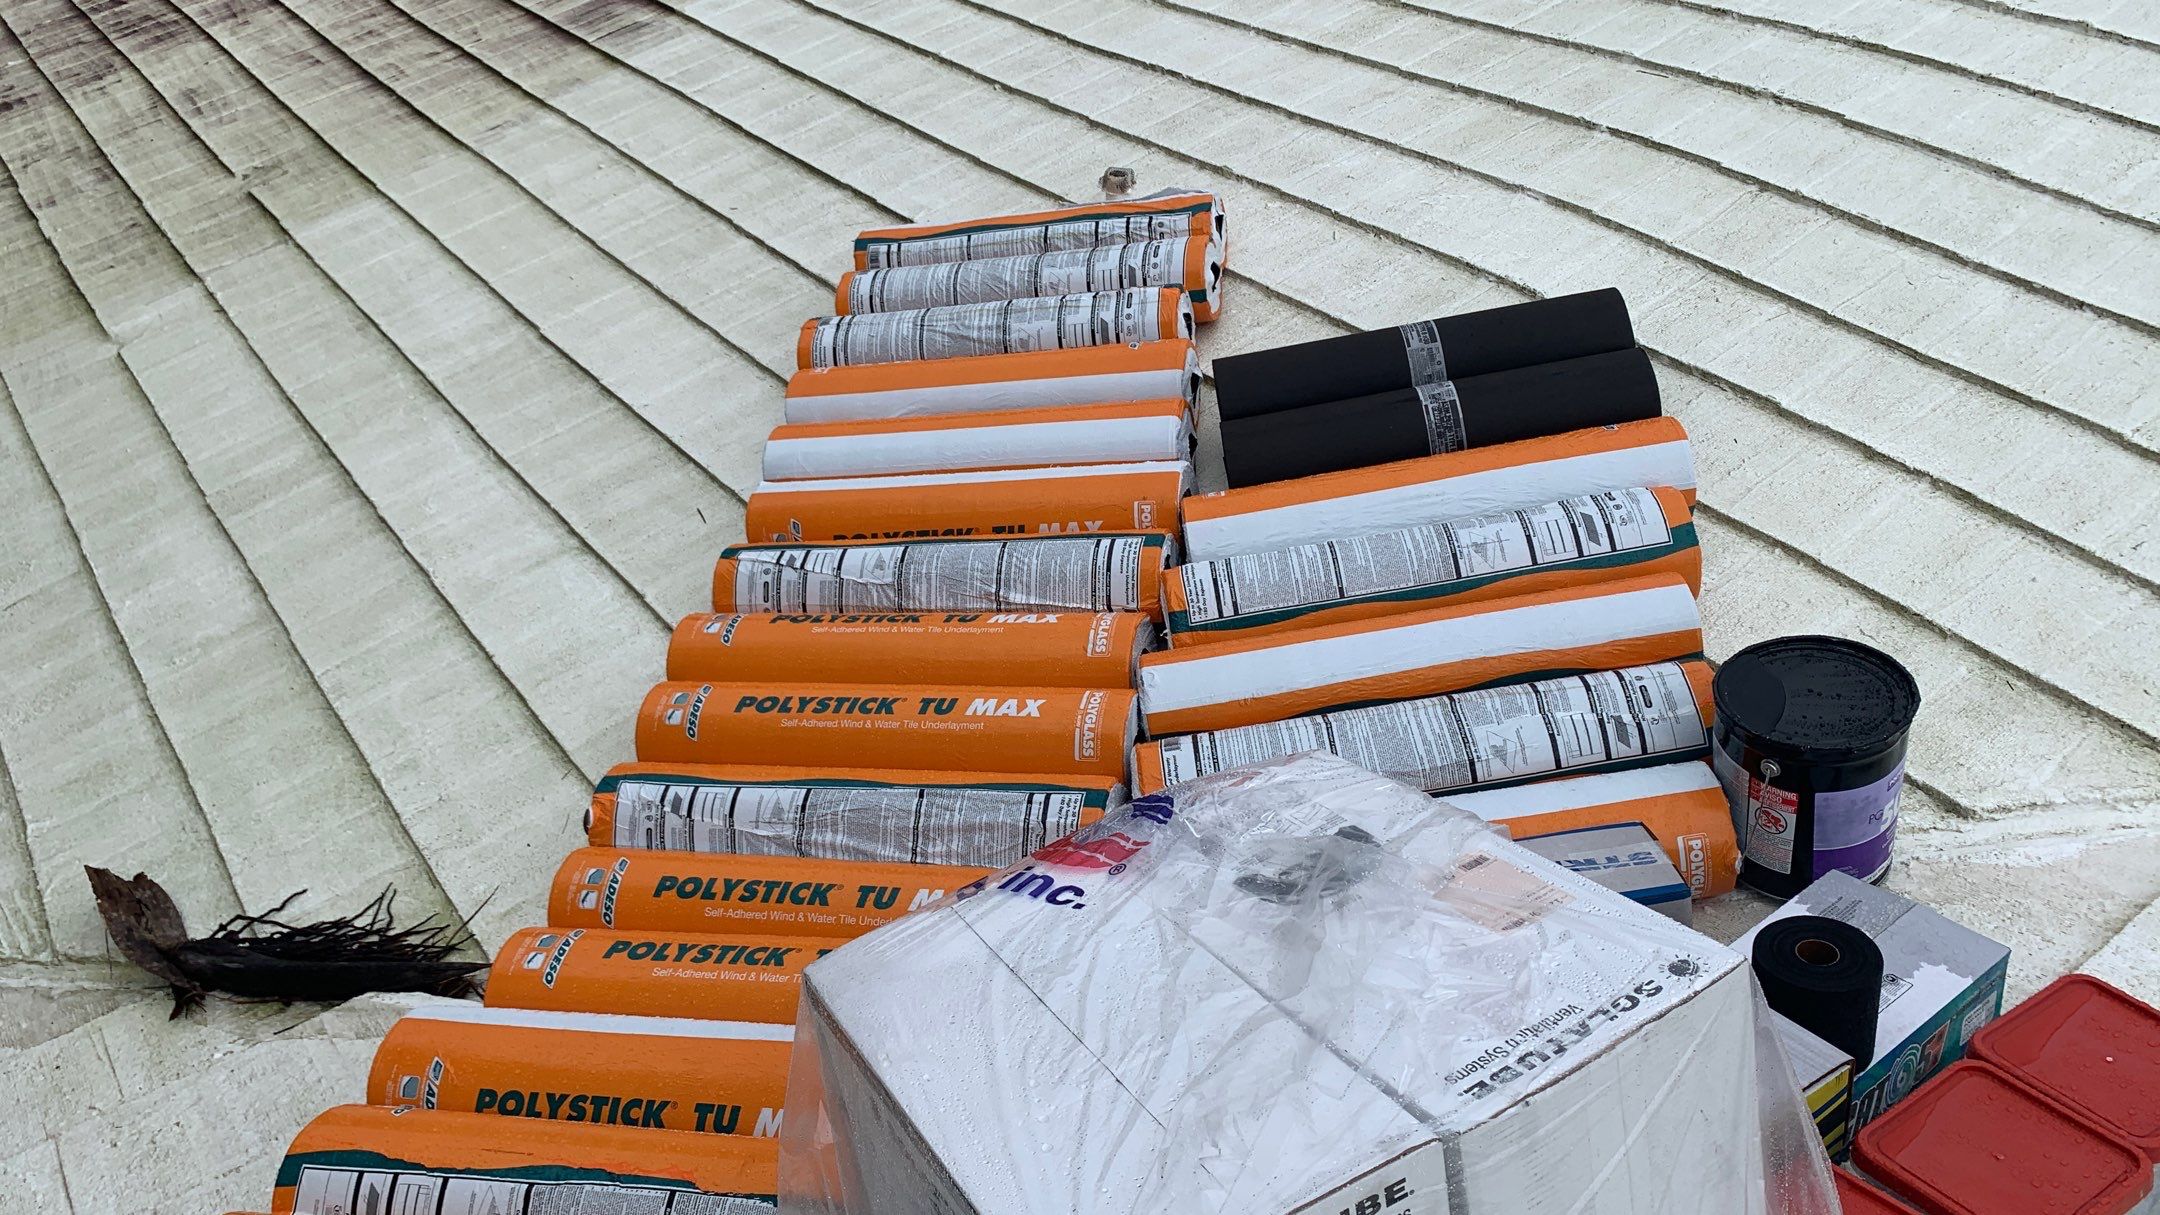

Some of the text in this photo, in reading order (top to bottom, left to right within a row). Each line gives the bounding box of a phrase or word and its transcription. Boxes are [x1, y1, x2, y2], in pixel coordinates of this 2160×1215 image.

[769, 614, 1063, 624] POLYSTICK TU MAX
[944, 626, 1004, 634] Underlayment
[687, 696, 702, 738] ADESO
[734, 695, 1046, 718] POLYSTICK TU MAX
[780, 718, 984, 731] Self-Adhered Wind & Water Tile Underlayment
[1083, 691, 1104, 757] POLYGLASS
[602, 873, 620, 926] ADESO
[653, 876, 838, 906] POLYSTICK
[856, 885, 901, 910] TU
[997, 866, 1086, 909] inc.
[704, 906, 768, 920] Self-Adhered
[770, 910, 795, 922] Wind
[797, 912, 804, 922] &
[807, 913, 836, 924] Water
[840, 914, 856, 925] Tile
[544, 939, 572, 985] ADESO
[602, 941, 796, 966] POLYSTICK
[652, 967, 718, 979] Self-Adhered
[721, 970, 746, 981] Wind
[749, 972, 757, 981] &
[759, 972, 786, 983] Water
[1444, 1046, 1510, 1085] Systems
[474, 1088, 672, 1128] POLYSTICK
[694, 1102, 742, 1134] TU
